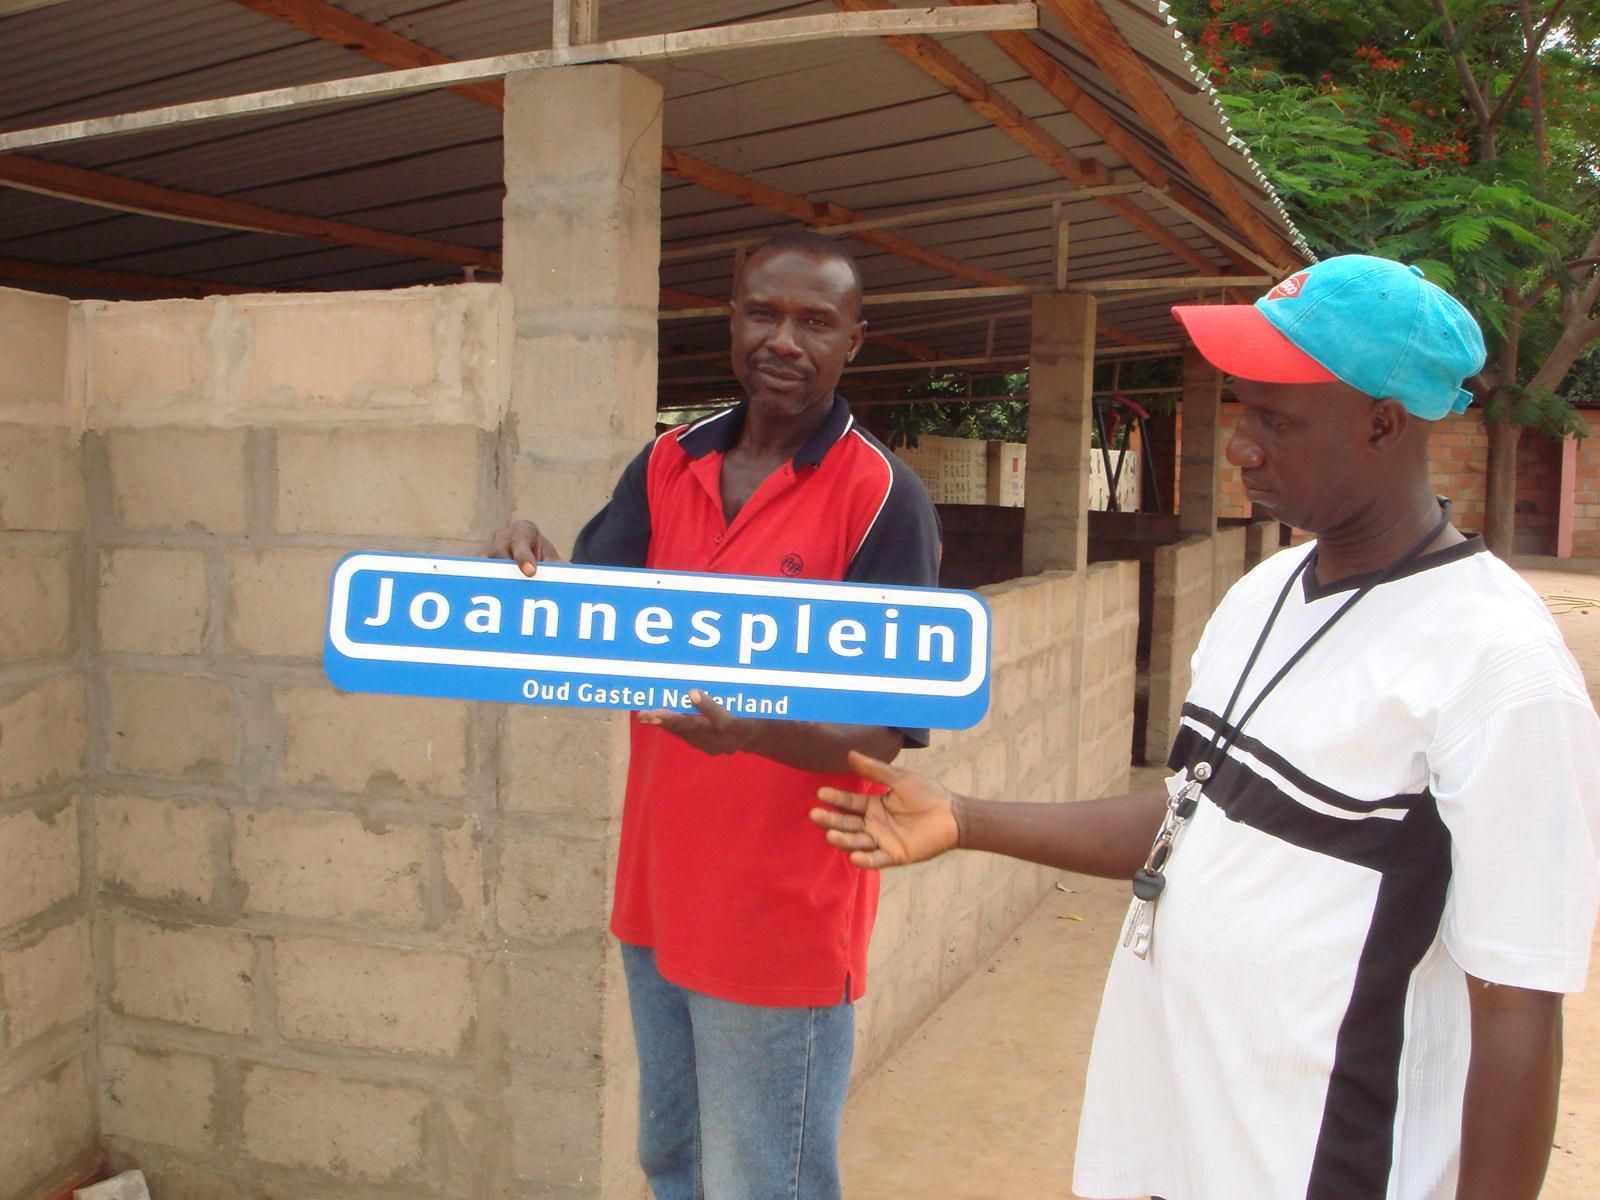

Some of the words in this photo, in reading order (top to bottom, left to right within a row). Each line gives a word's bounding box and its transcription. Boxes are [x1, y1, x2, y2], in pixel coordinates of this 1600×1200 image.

[363, 577, 956, 665] Joannesplein
[522, 679, 570, 701] Oud
[577, 682, 655, 707] Gastel
[662, 688, 789, 715] Neerland
